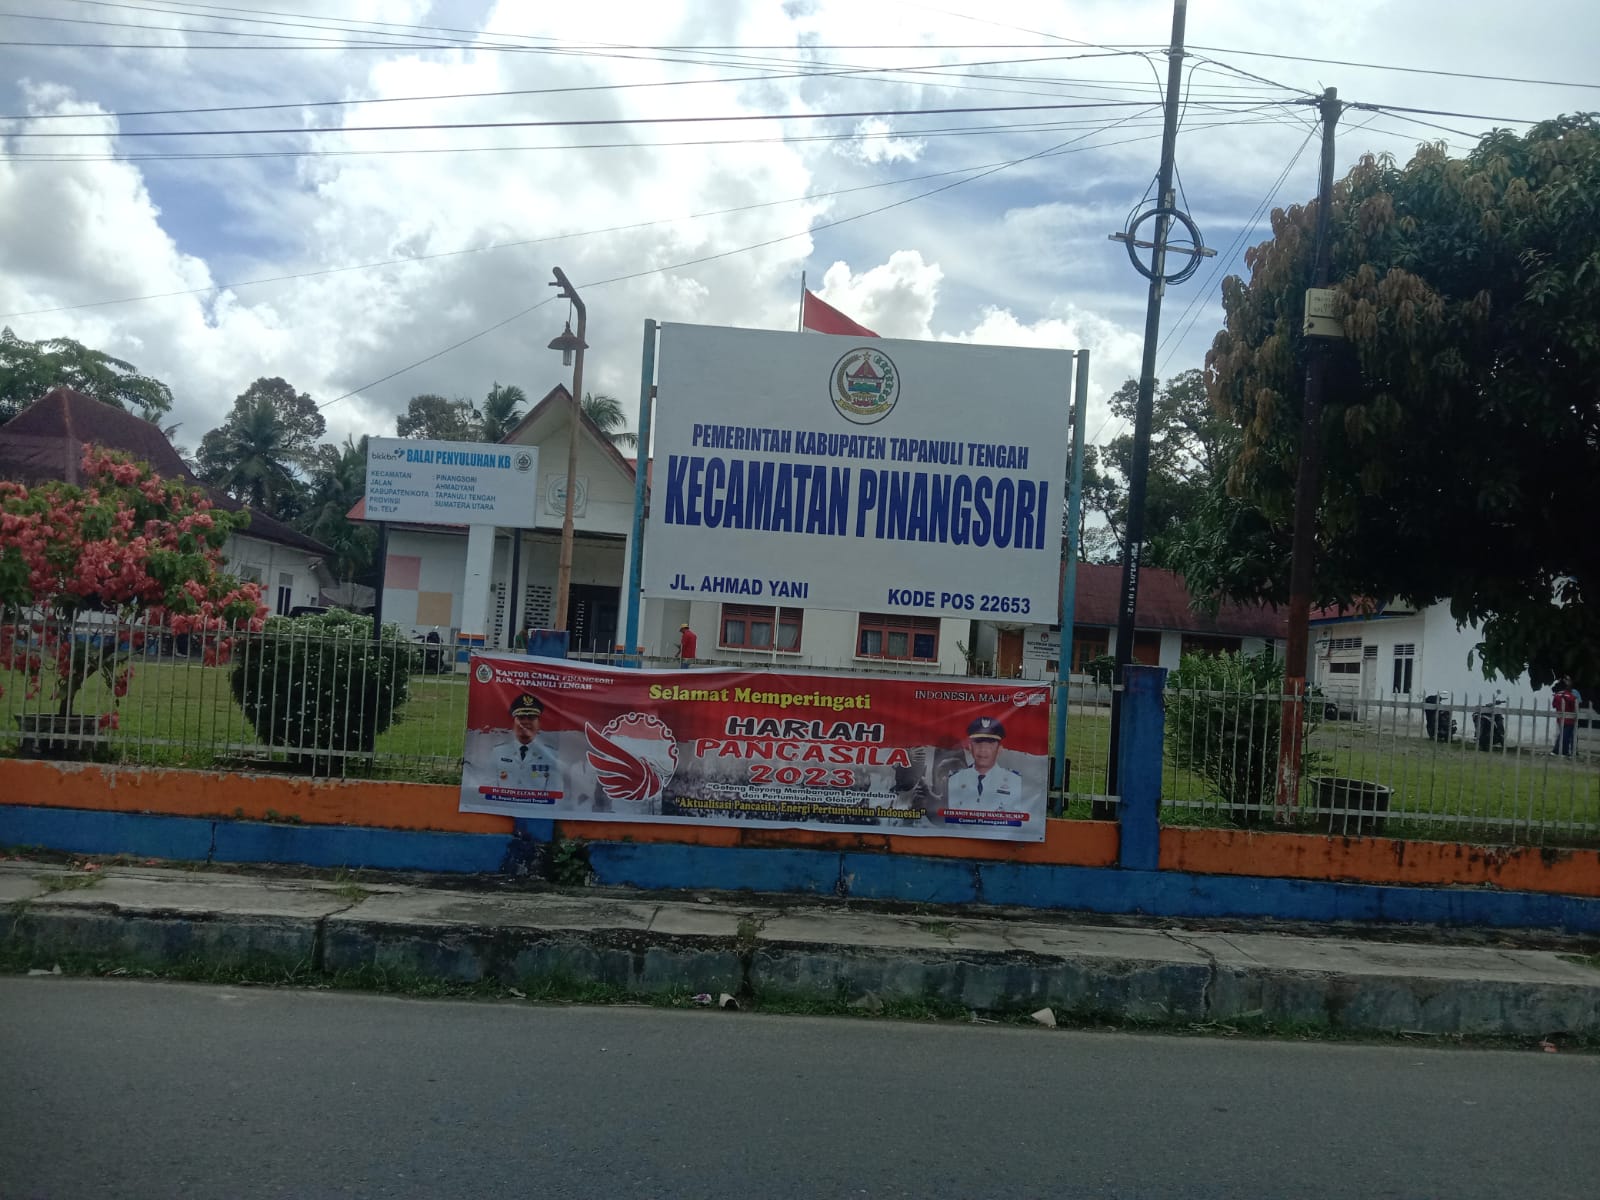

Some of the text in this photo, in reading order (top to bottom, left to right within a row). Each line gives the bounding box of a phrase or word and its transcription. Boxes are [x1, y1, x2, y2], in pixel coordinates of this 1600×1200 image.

[692, 423, 1029, 471] PEMERINTAH KABUPATEN TAPANULI TENGAH
[406, 449, 511, 469] BALAI PENYULUHAN KB
[371, 470, 477, 483] KECAMATAN PINANGSORI
[369, 496, 401, 504] PROVINSI
[434, 501, 471, 509] SUMATERA
[435, 491, 467, 500] TAPANULI
[469, 494, 496, 502] TENGAH
[664, 454, 1049, 550] KECAMATAN PINANGSORI
[669, 574, 809, 600] JL. AHMAD YANI
[888, 588, 1031, 615] KODE POS 22653
[495, 668, 529, 679] KANTOR
[531, 672, 560, 681] CAMAT
[516, 678, 556, 688] TAPANULI
[559, 682, 593, 690] TENGAH
[649, 684, 871, 711] Selamat Memperingati
[915, 690, 1010, 704] INDONESIA MAJU
[726, 716, 884, 743] HARLAH
[694, 738, 912, 768] PANCASILA
[748, 763, 856, 788] 2023
[762, 794, 823, 802] Pertumbuhan
[784, 787, 840, 797] Membangun
[781, 802, 811, 815] Energi
[812, 804, 875, 816] Pertumbuhan
